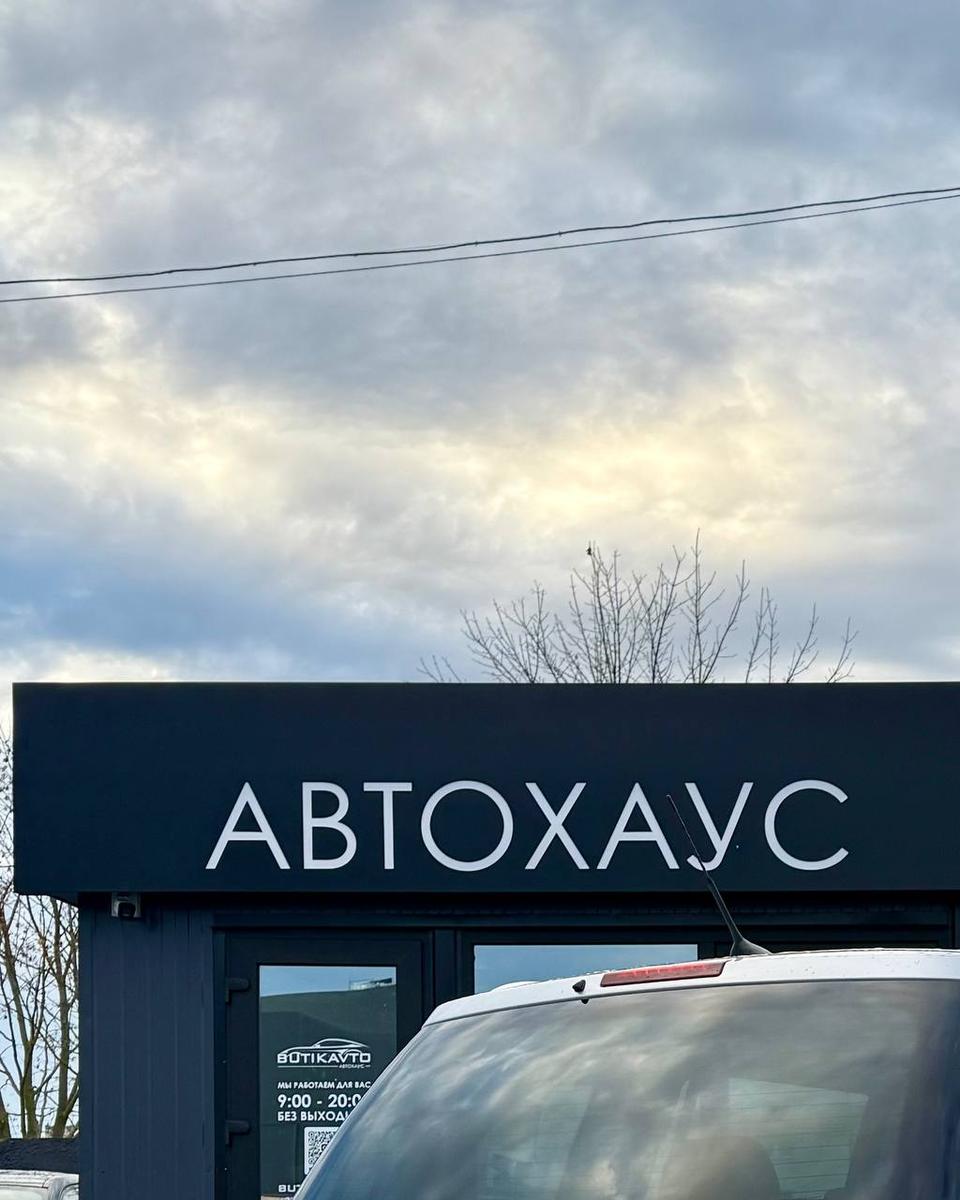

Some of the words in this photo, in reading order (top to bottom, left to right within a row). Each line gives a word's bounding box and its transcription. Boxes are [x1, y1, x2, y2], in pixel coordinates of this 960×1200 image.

[205, 779, 849, 872] АВТОХАУС
[277, 1052, 371, 1064] BUTIKAVTO
[277, 1081, 292, 1089] МЫ
[293, 1081, 335, 1089] РАБОТАЕМ
[336, 1081, 353, 1090] ДЛЯ
[277, 1093, 312, 1109] 9:00
[327, 1093, 362, 1108] 20:0
[277, 1111, 297, 1122] БЕЗ
[300, 1111, 349, 1122] ВЫХОД
